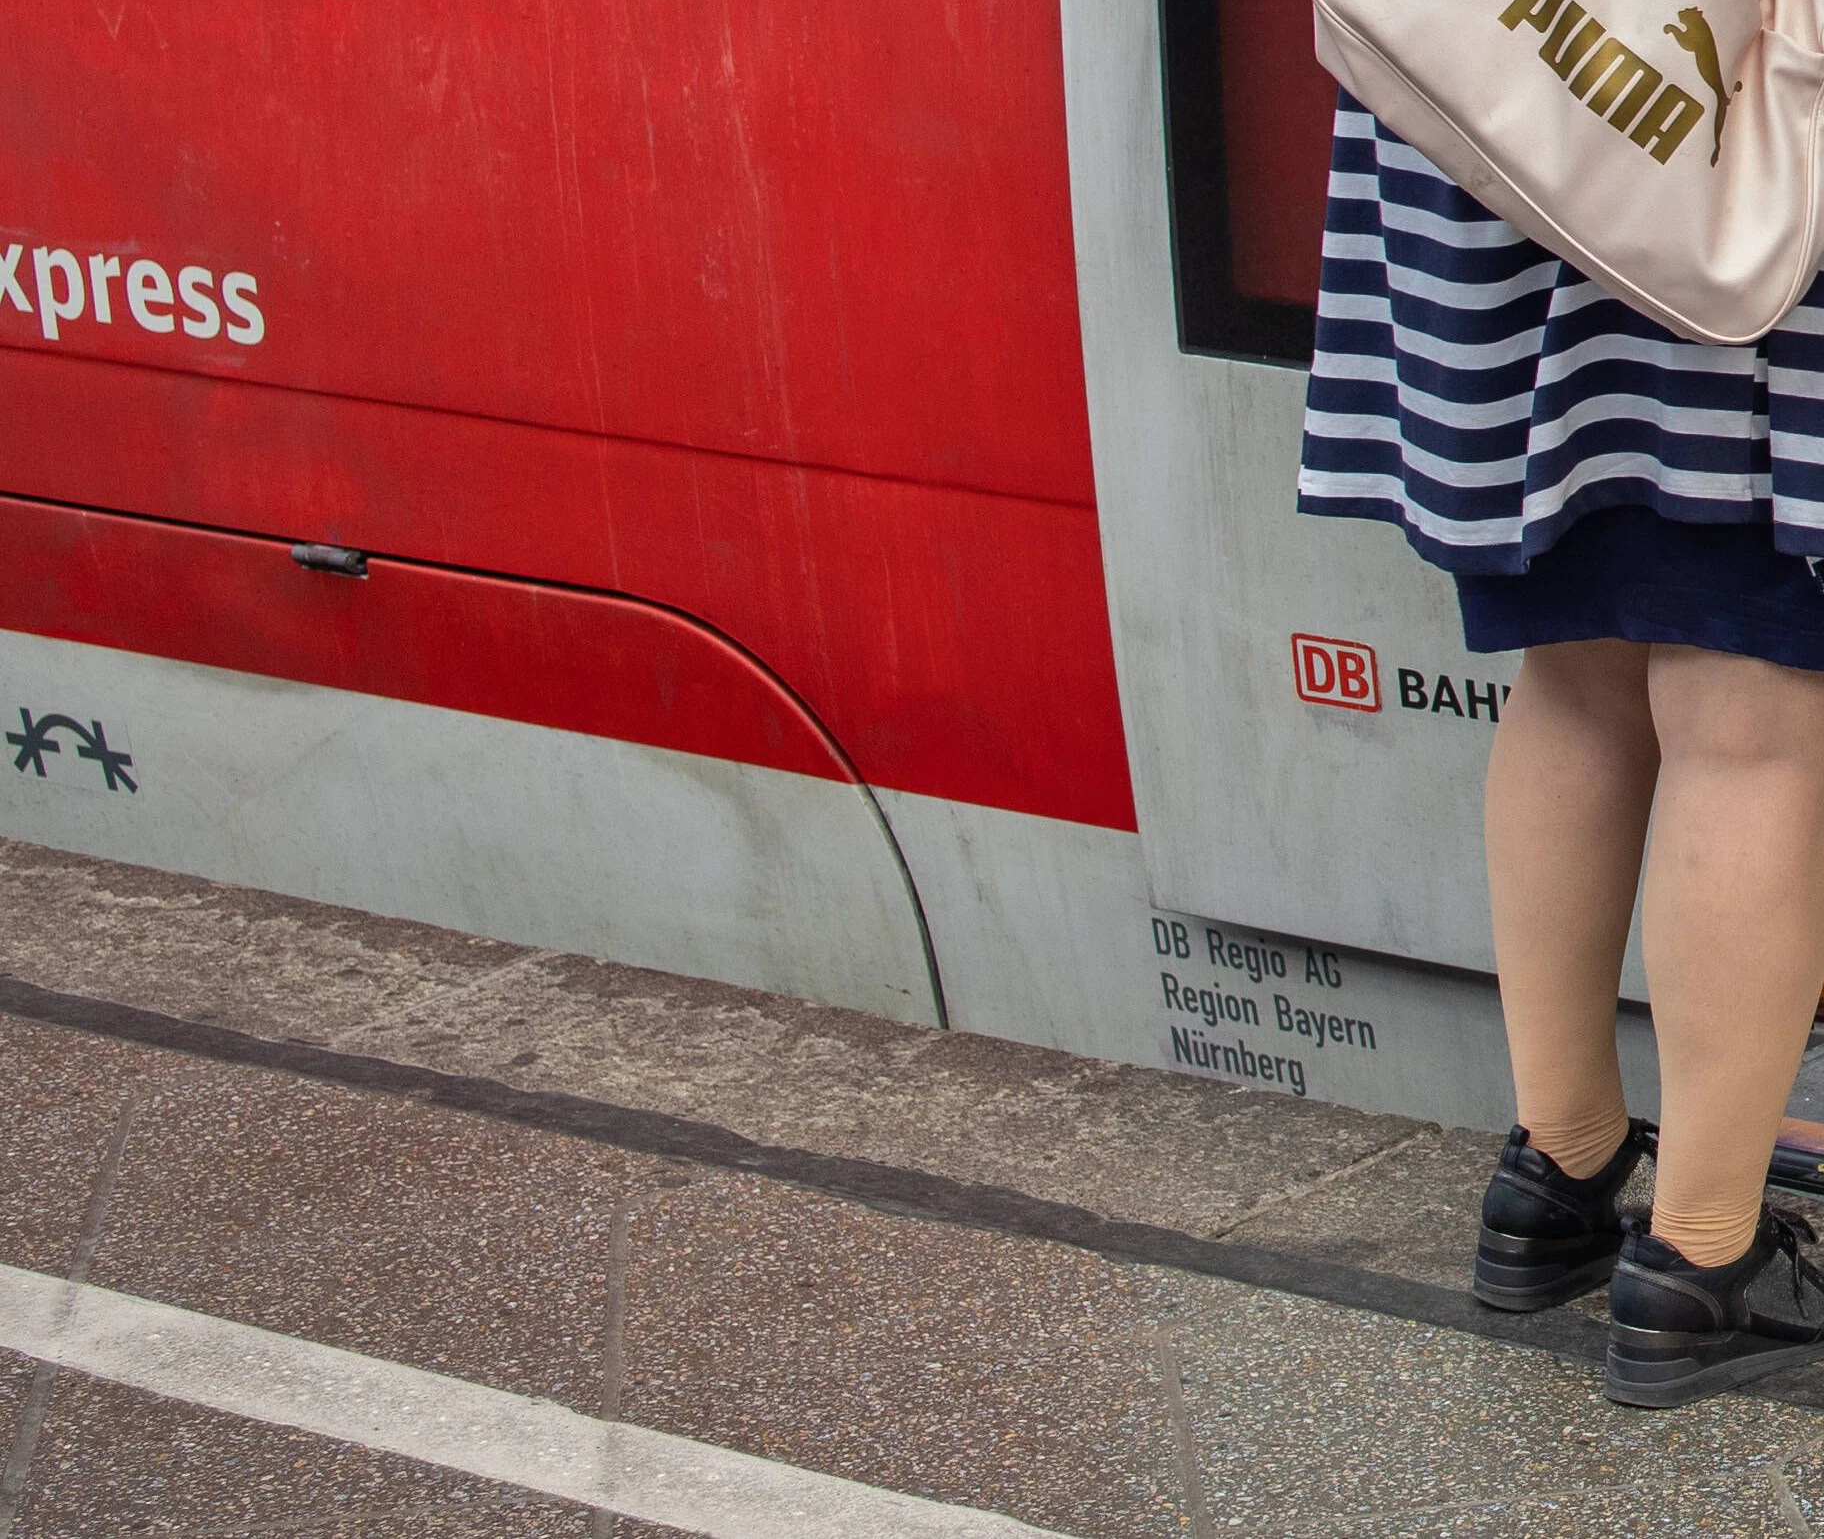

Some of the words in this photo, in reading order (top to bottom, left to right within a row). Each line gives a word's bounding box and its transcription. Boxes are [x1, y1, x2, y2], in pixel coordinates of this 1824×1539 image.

[1301, 645, 1369, 701] DB
[1397, 667, 1512, 723] BAH
[1151, 917, 1191, 960] DB
[1205, 928, 1287, 984] Regio
[1305, 950, 1342, 989] AG
[1160, 972, 1259, 1027] Region
[1275, 996, 1377, 1050] Bayern
[1170, 1025, 1306, 1096] Nürnberg
